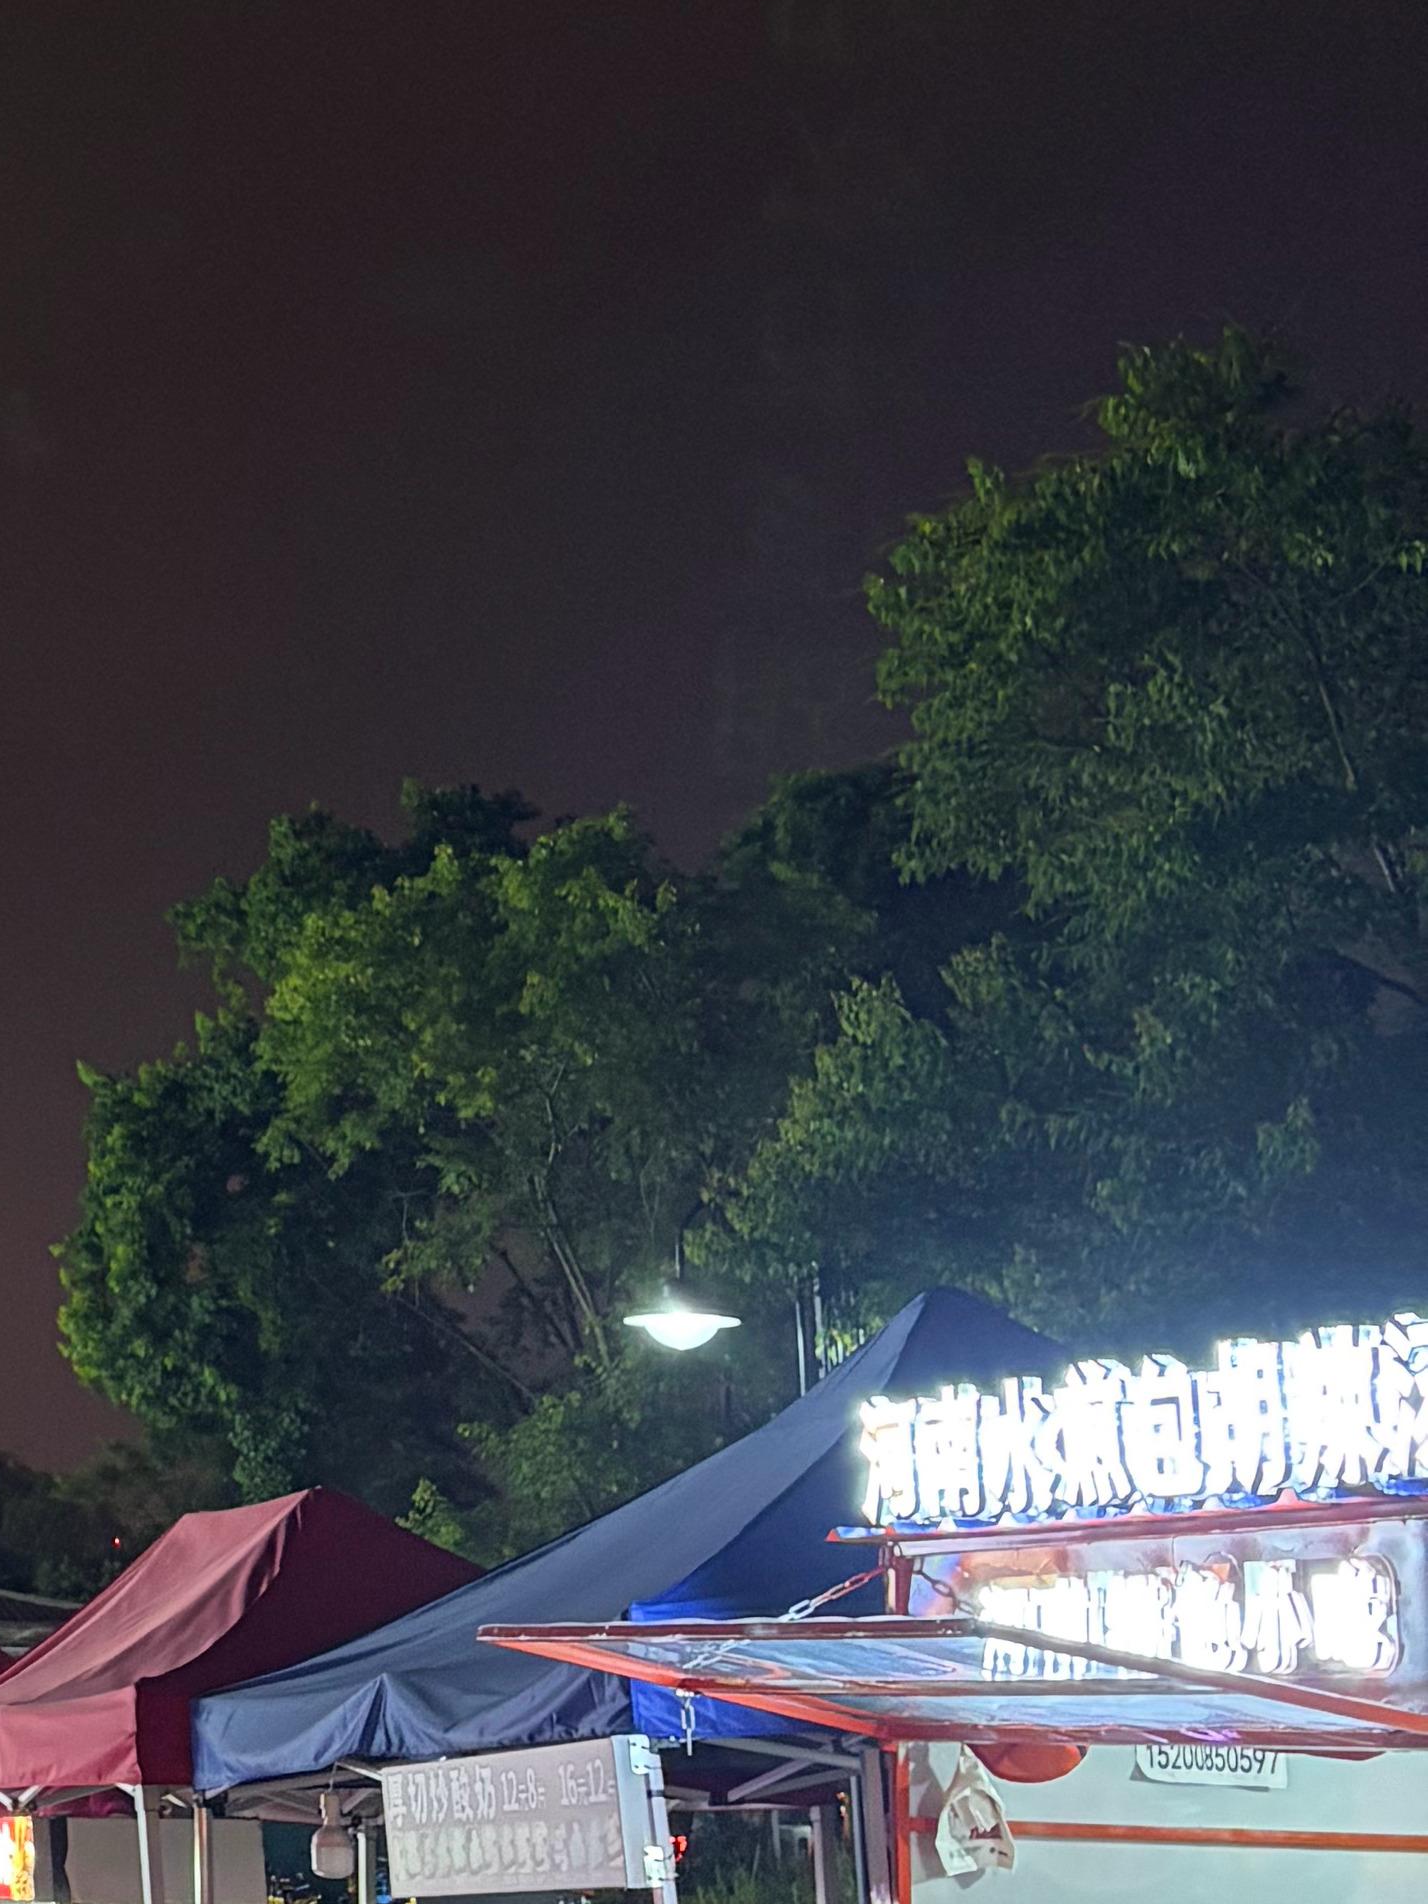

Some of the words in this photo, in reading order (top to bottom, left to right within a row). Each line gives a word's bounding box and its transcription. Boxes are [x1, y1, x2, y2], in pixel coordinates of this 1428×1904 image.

[386, 1763, 497, 1828] 厚切炒酸奶
